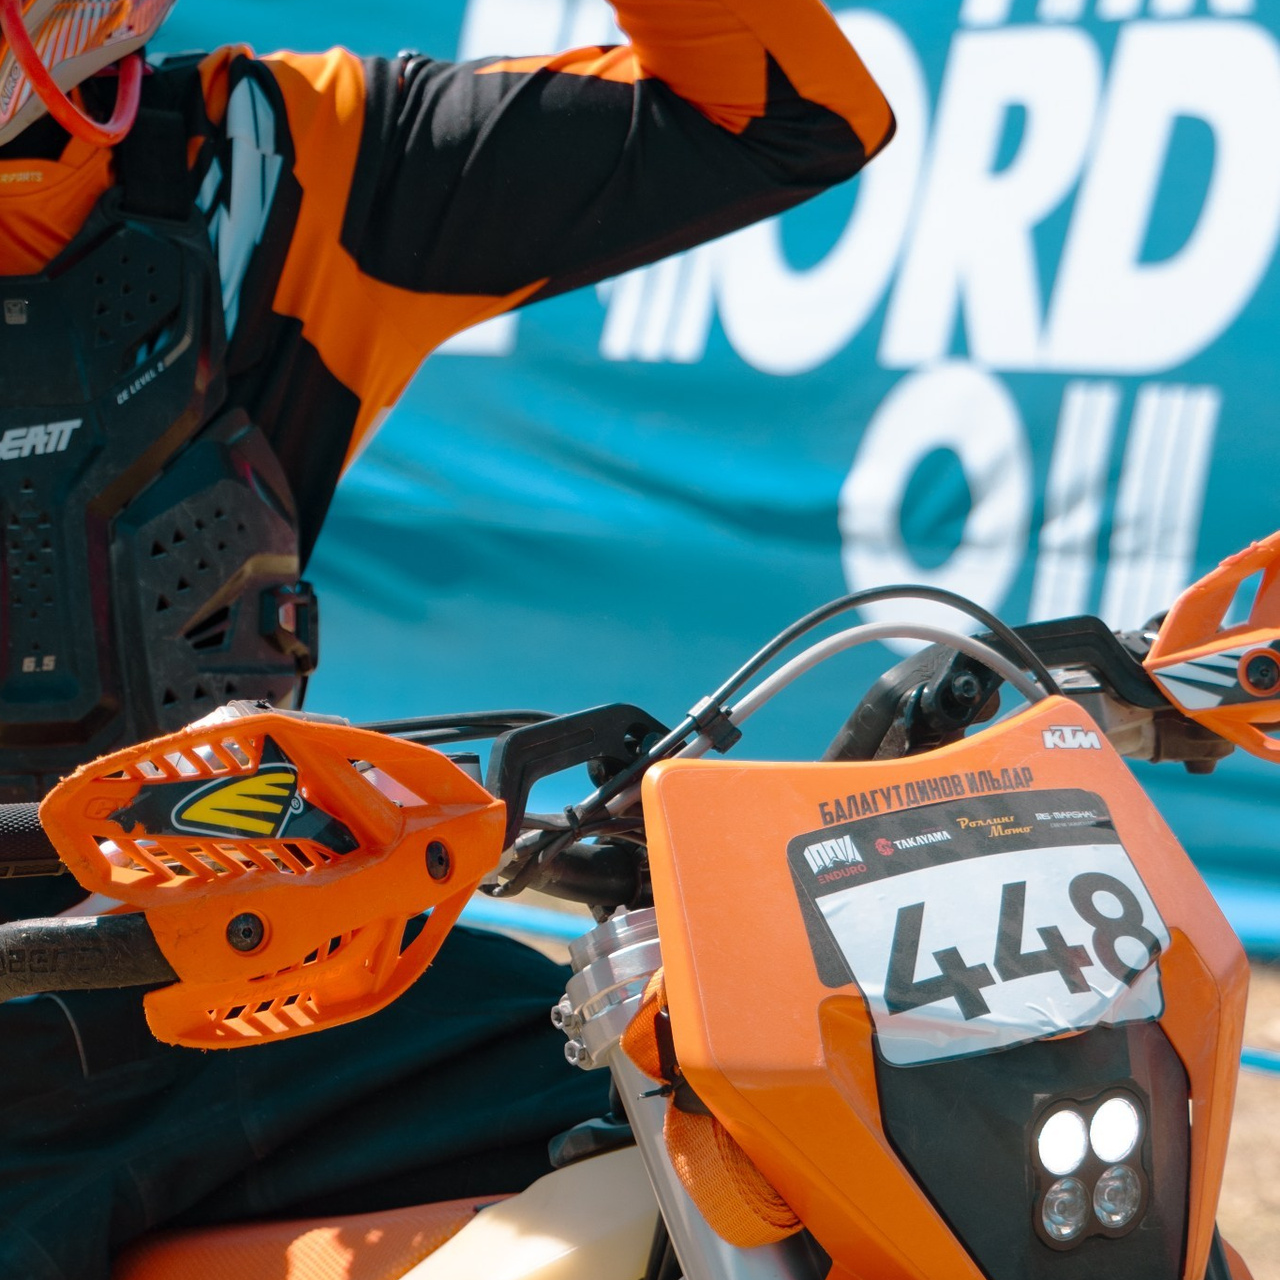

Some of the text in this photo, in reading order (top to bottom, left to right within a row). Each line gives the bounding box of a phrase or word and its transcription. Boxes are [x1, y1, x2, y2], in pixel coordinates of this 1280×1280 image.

[0, 63, 21, 116] AIRO
[1042, 725, 1102, 750] KTM
[818, 766, 1035, 826] БАЛАГУТДИНОВ ИЛЬДАР
[893, 830, 952, 850] TAKAYAMA
[817, 863, 868, 884] ENDURO
[883, 871, 1162, 1021] 448
